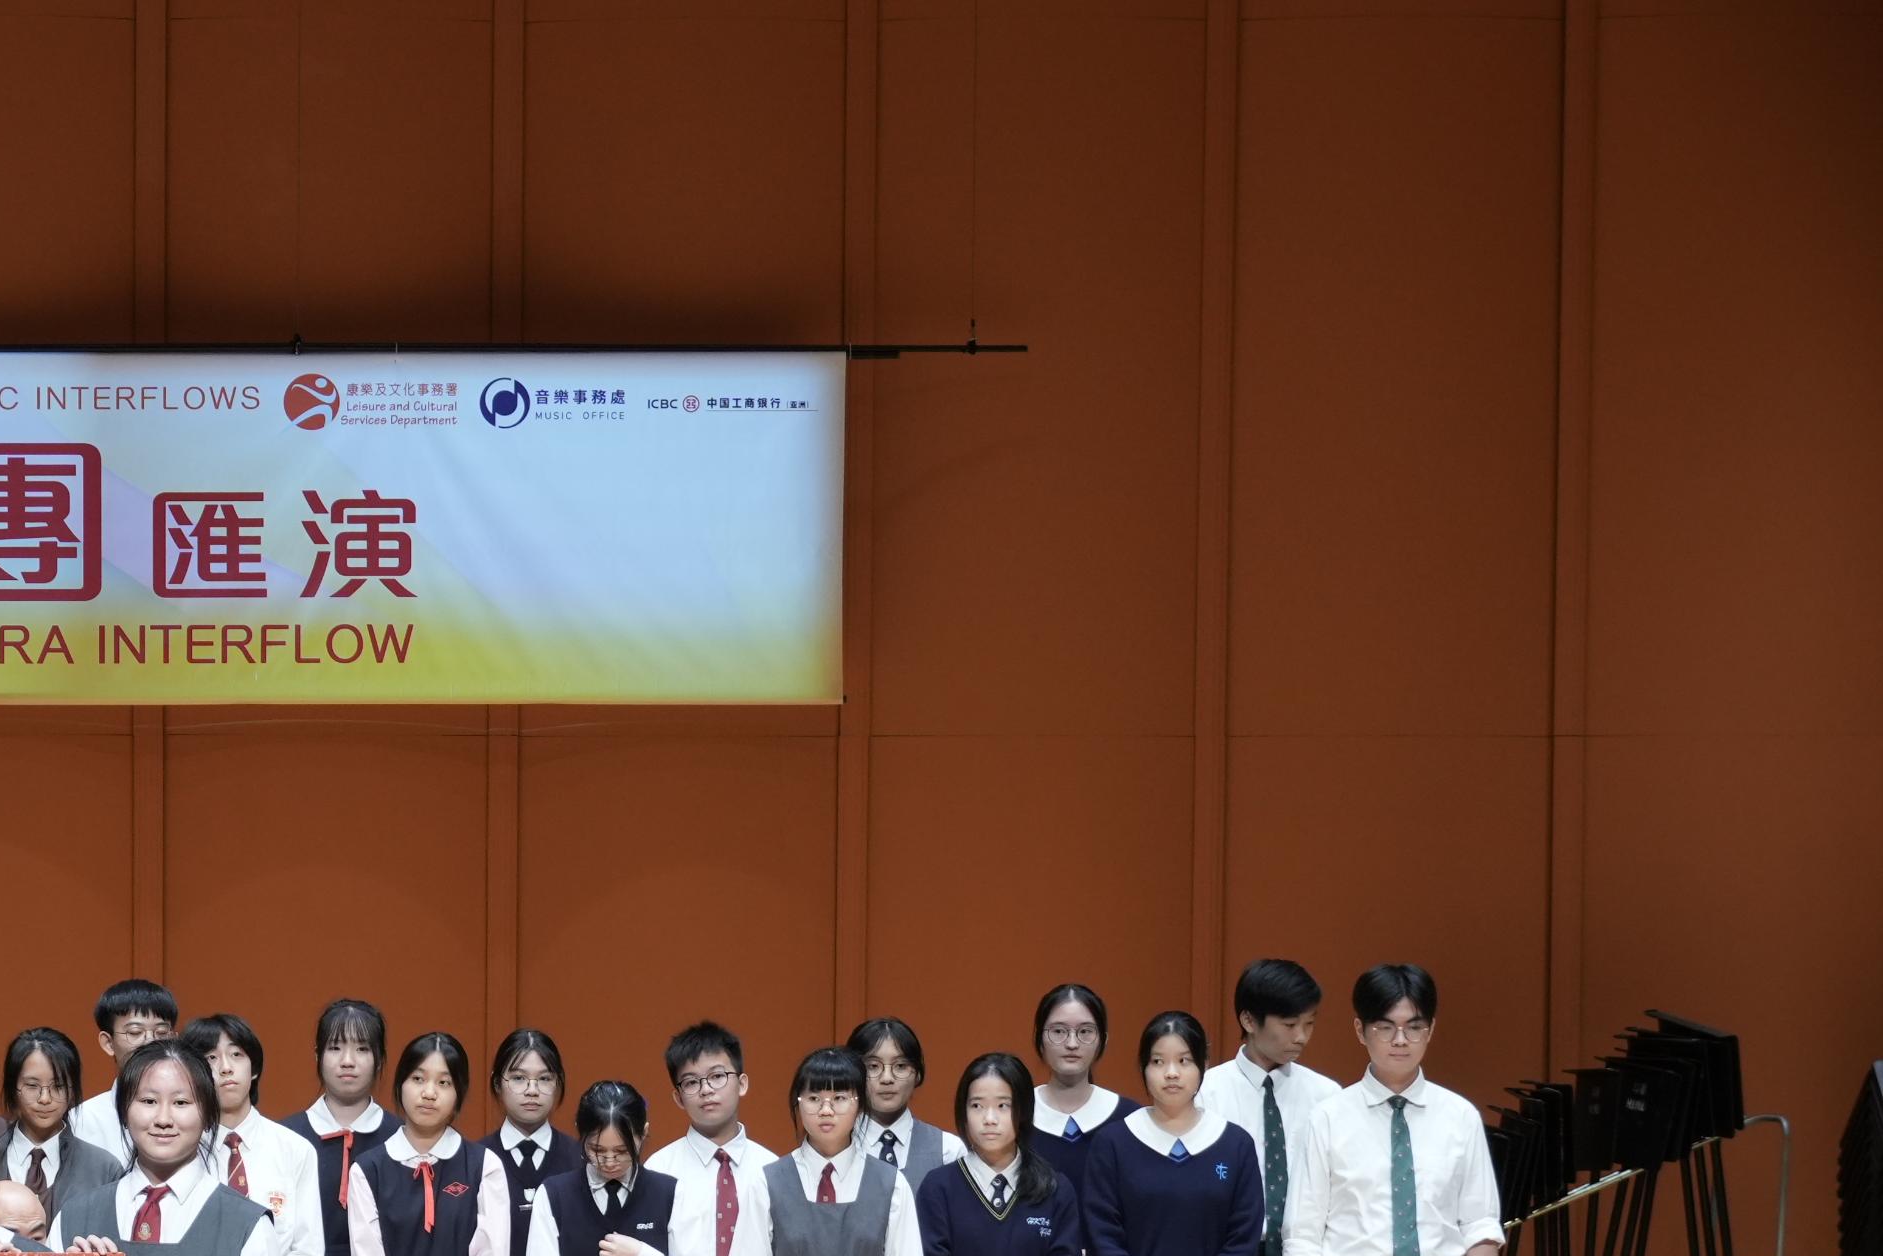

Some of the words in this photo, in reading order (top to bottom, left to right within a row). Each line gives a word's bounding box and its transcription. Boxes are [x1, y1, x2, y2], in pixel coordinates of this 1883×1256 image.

[346, 383, 458, 397] 康樂及文化事務署
[534, 388, 626, 405] 音樂事務處
[36, 385, 260, 411] INTERFLOWS
[647, 398, 679, 409] ICBC
[346, 401, 386, 412] Leisure
[389, 401, 410, 412] and
[413, 401, 458, 412] Cultural
[340, 415, 387, 426] Services
[390, 415, 458, 429] Department
[535, 411, 573, 420] MUSIC
[582, 411, 625, 420] OFFICE
[99, 625, 414, 666] INTERFLOW
